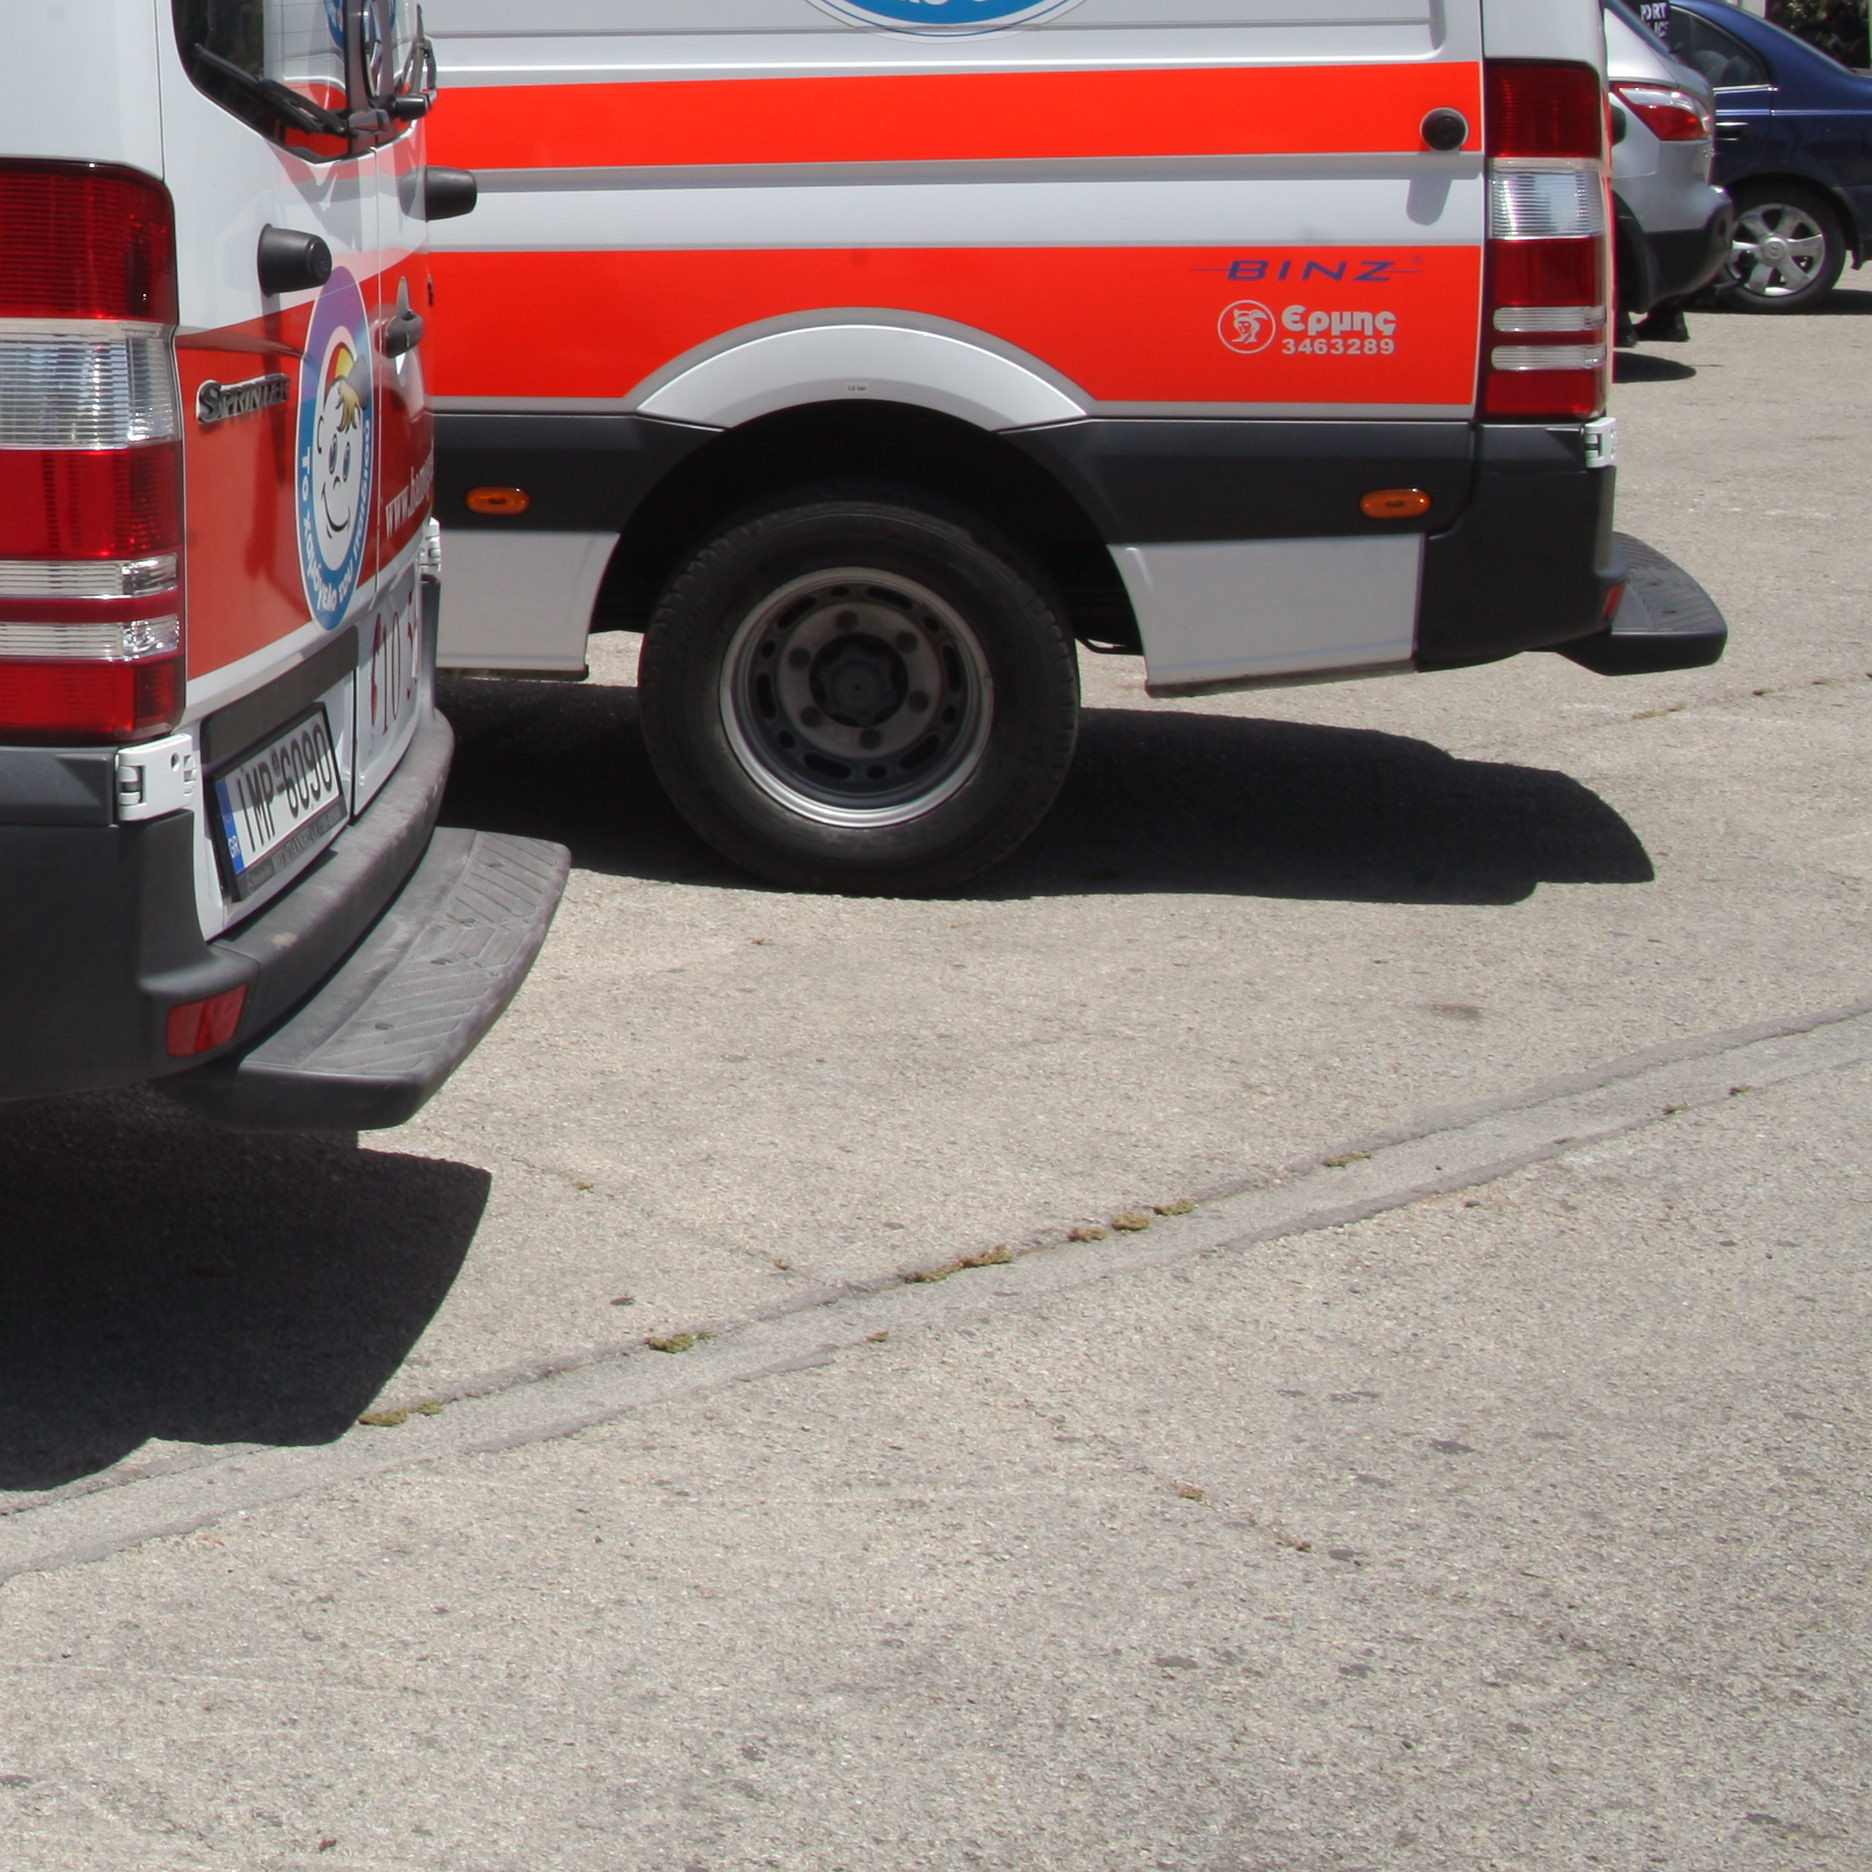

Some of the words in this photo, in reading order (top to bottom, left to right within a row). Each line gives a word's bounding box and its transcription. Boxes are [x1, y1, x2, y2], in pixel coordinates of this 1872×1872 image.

[1226, 259, 1396, 282] BINZ
[1281, 304, 1397, 337] Ερμης
[1281, 338, 1396, 355] 3463289
